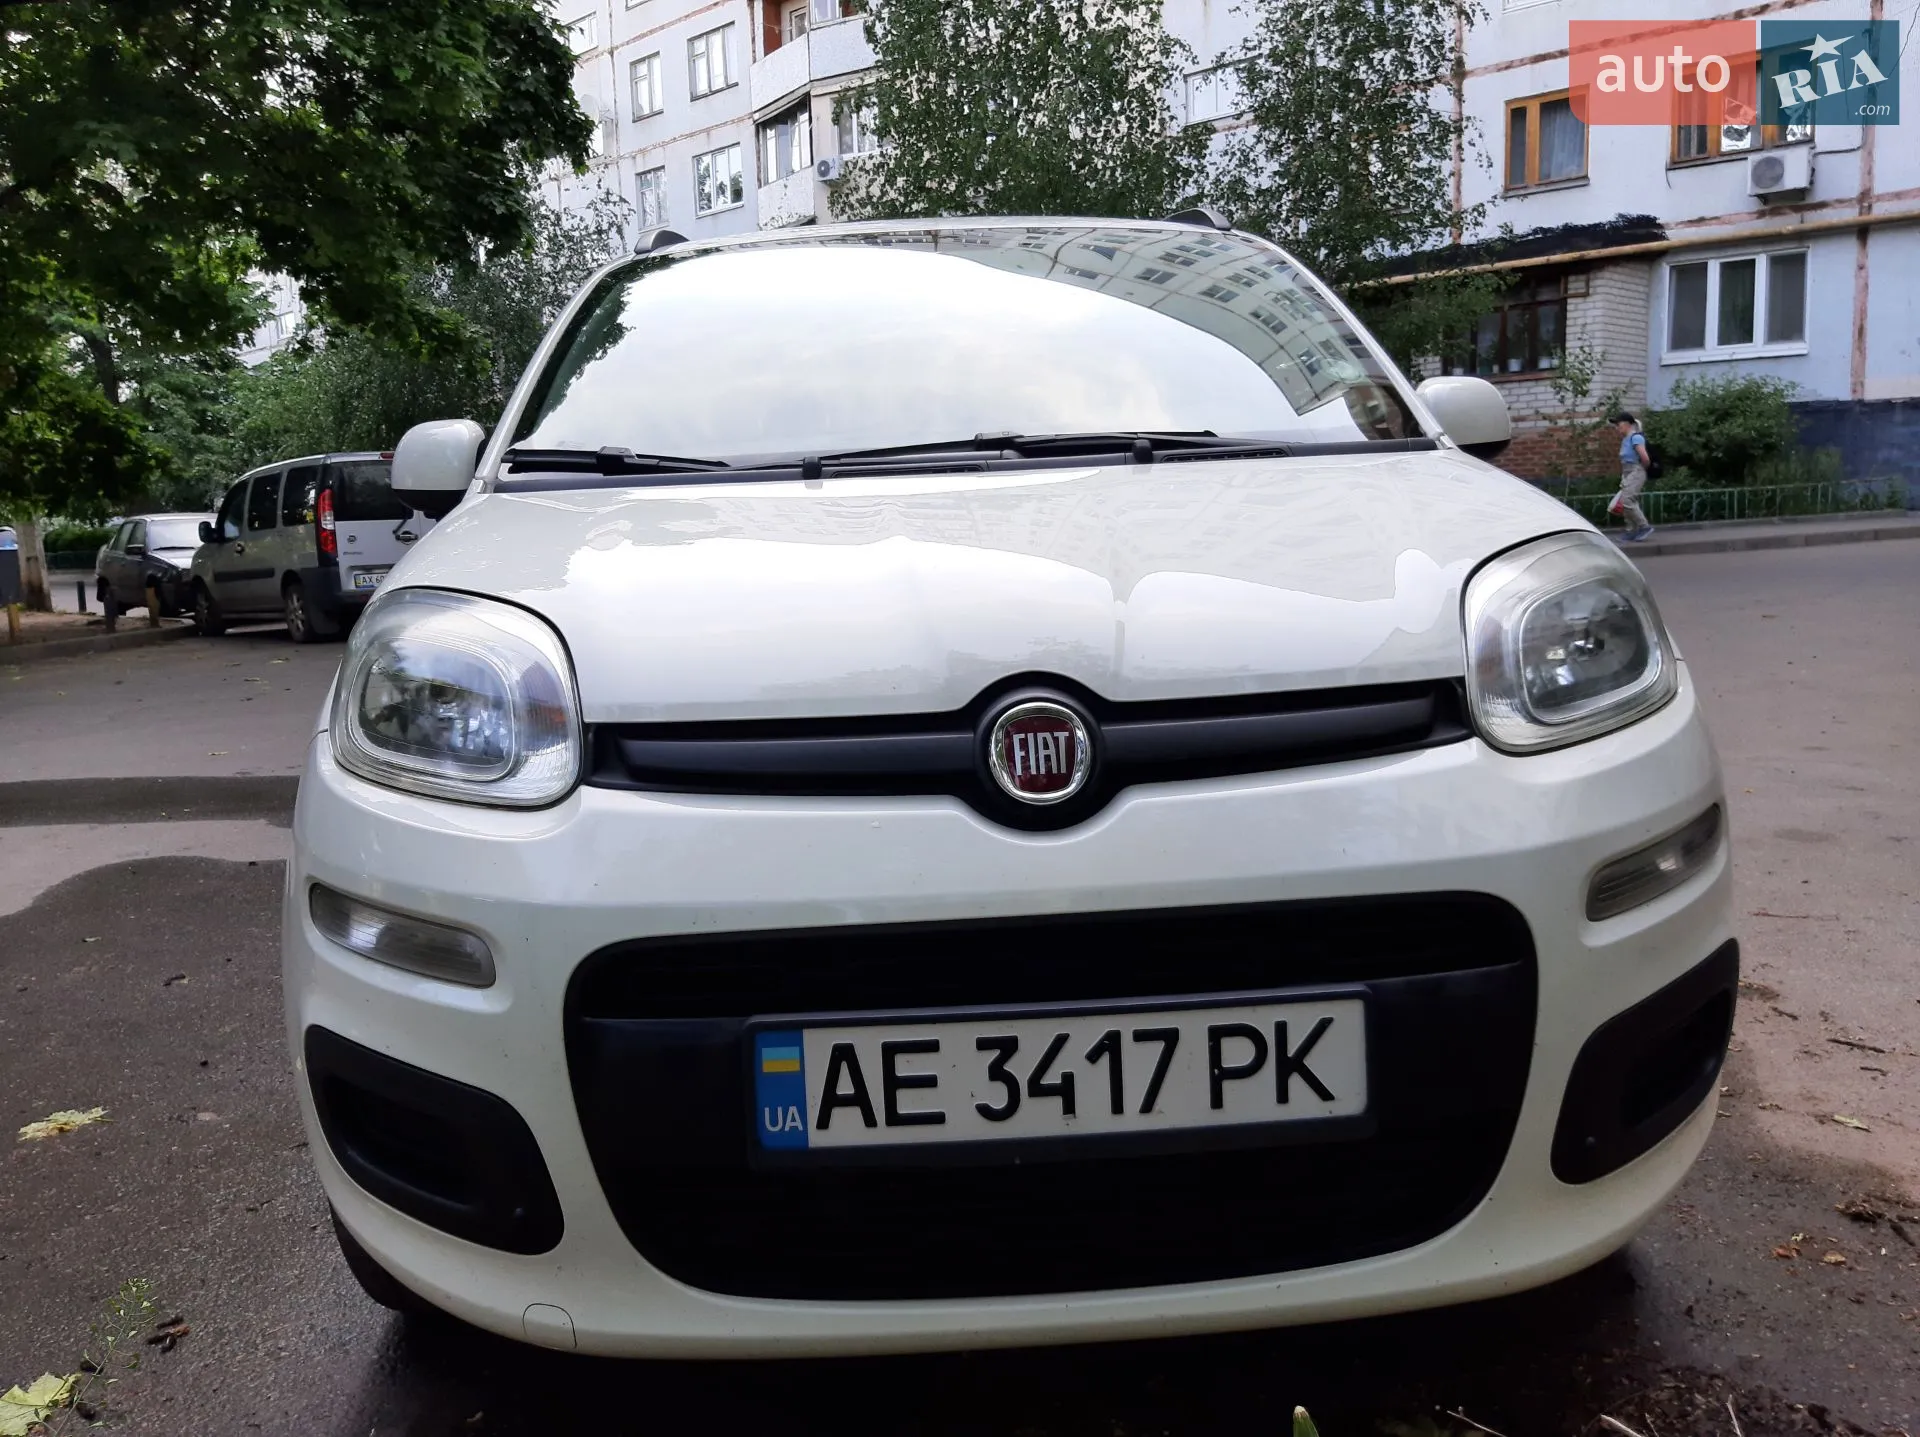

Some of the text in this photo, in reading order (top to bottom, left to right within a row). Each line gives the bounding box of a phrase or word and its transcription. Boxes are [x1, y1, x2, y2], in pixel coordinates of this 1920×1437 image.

[362, 575, 374, 584] AX
[1012, 731, 1069, 776] FIAT
[814, 1016, 1335, 1130] AE 3417 PK
[763, 1105, 803, 1132] UA
